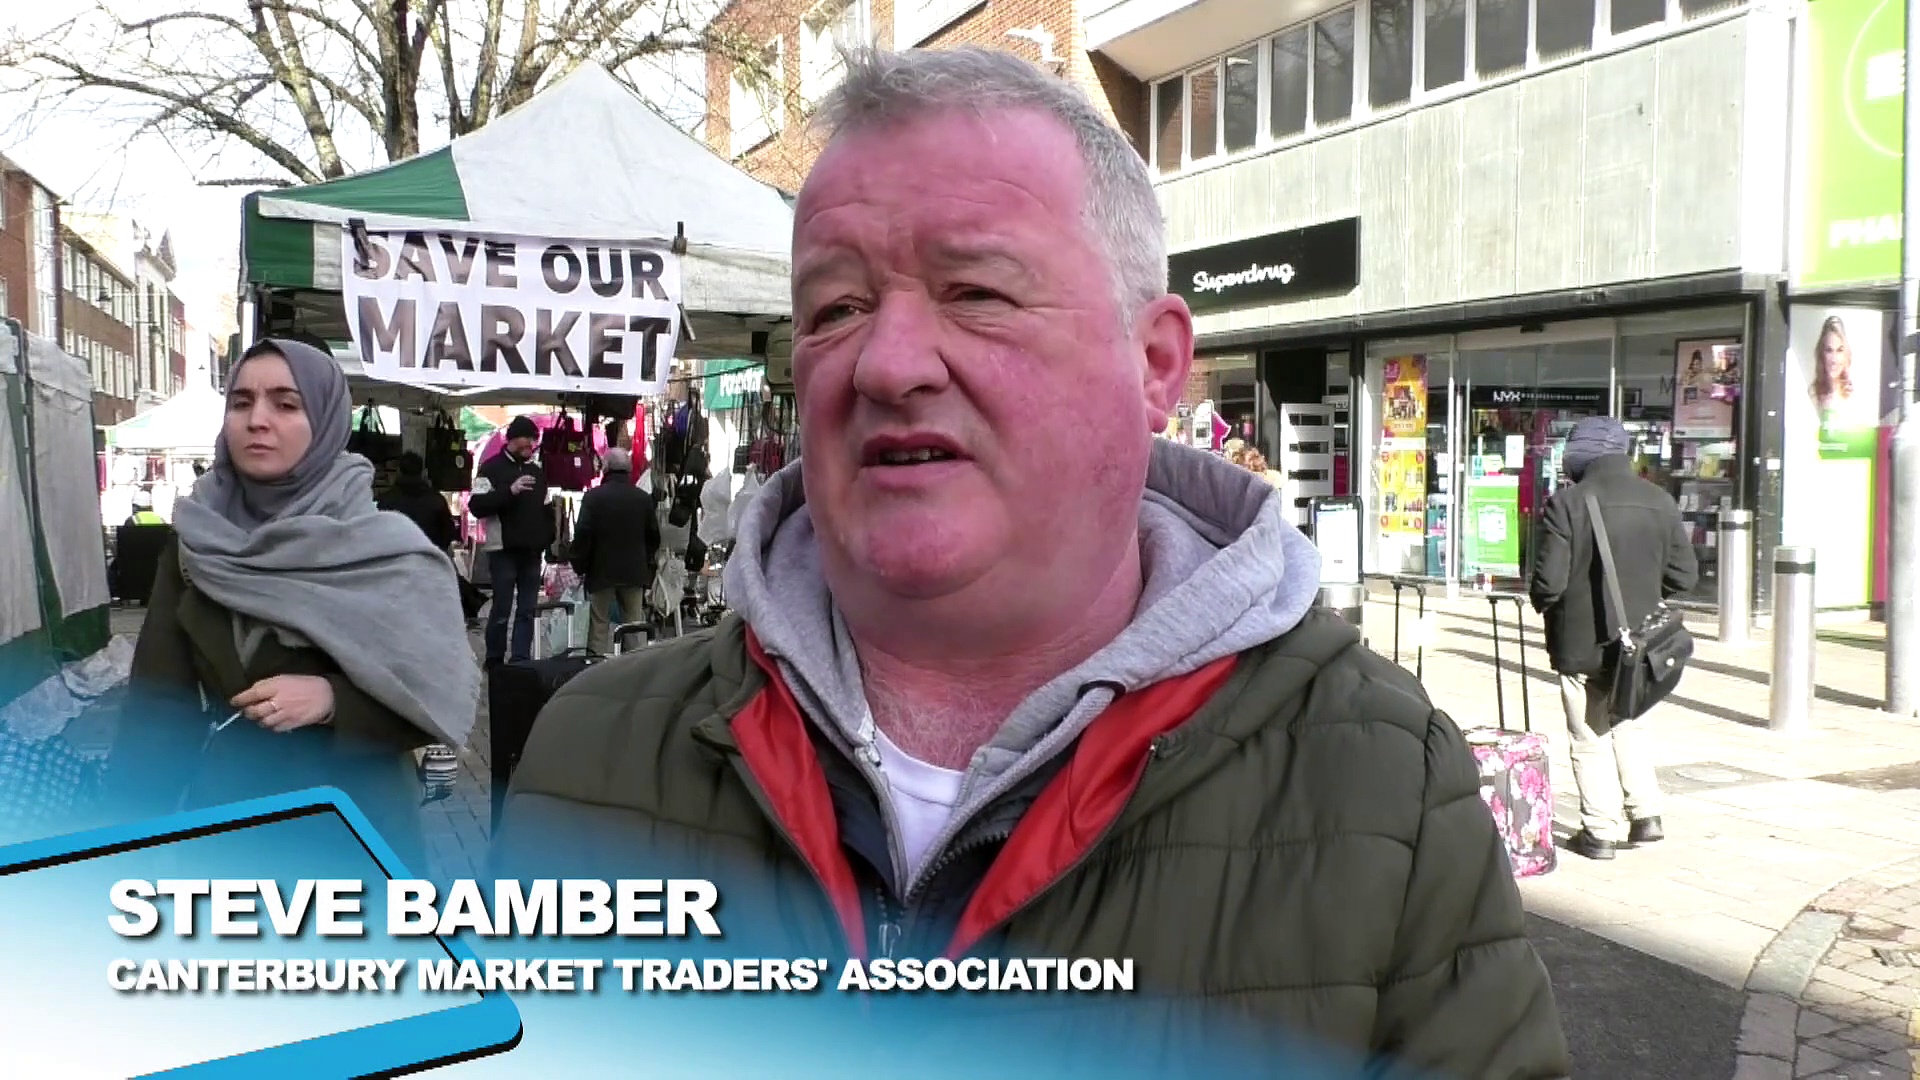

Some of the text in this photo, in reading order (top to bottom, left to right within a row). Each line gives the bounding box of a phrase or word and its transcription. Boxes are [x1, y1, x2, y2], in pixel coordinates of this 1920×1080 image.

[1829, 213, 1903, 248] PHA
[352, 231, 670, 301] SAVE OUR
[1193, 263, 1295, 293] Superdrug
[357, 295, 672, 382] MARKET
[1493, 390, 1520, 402] NYX
